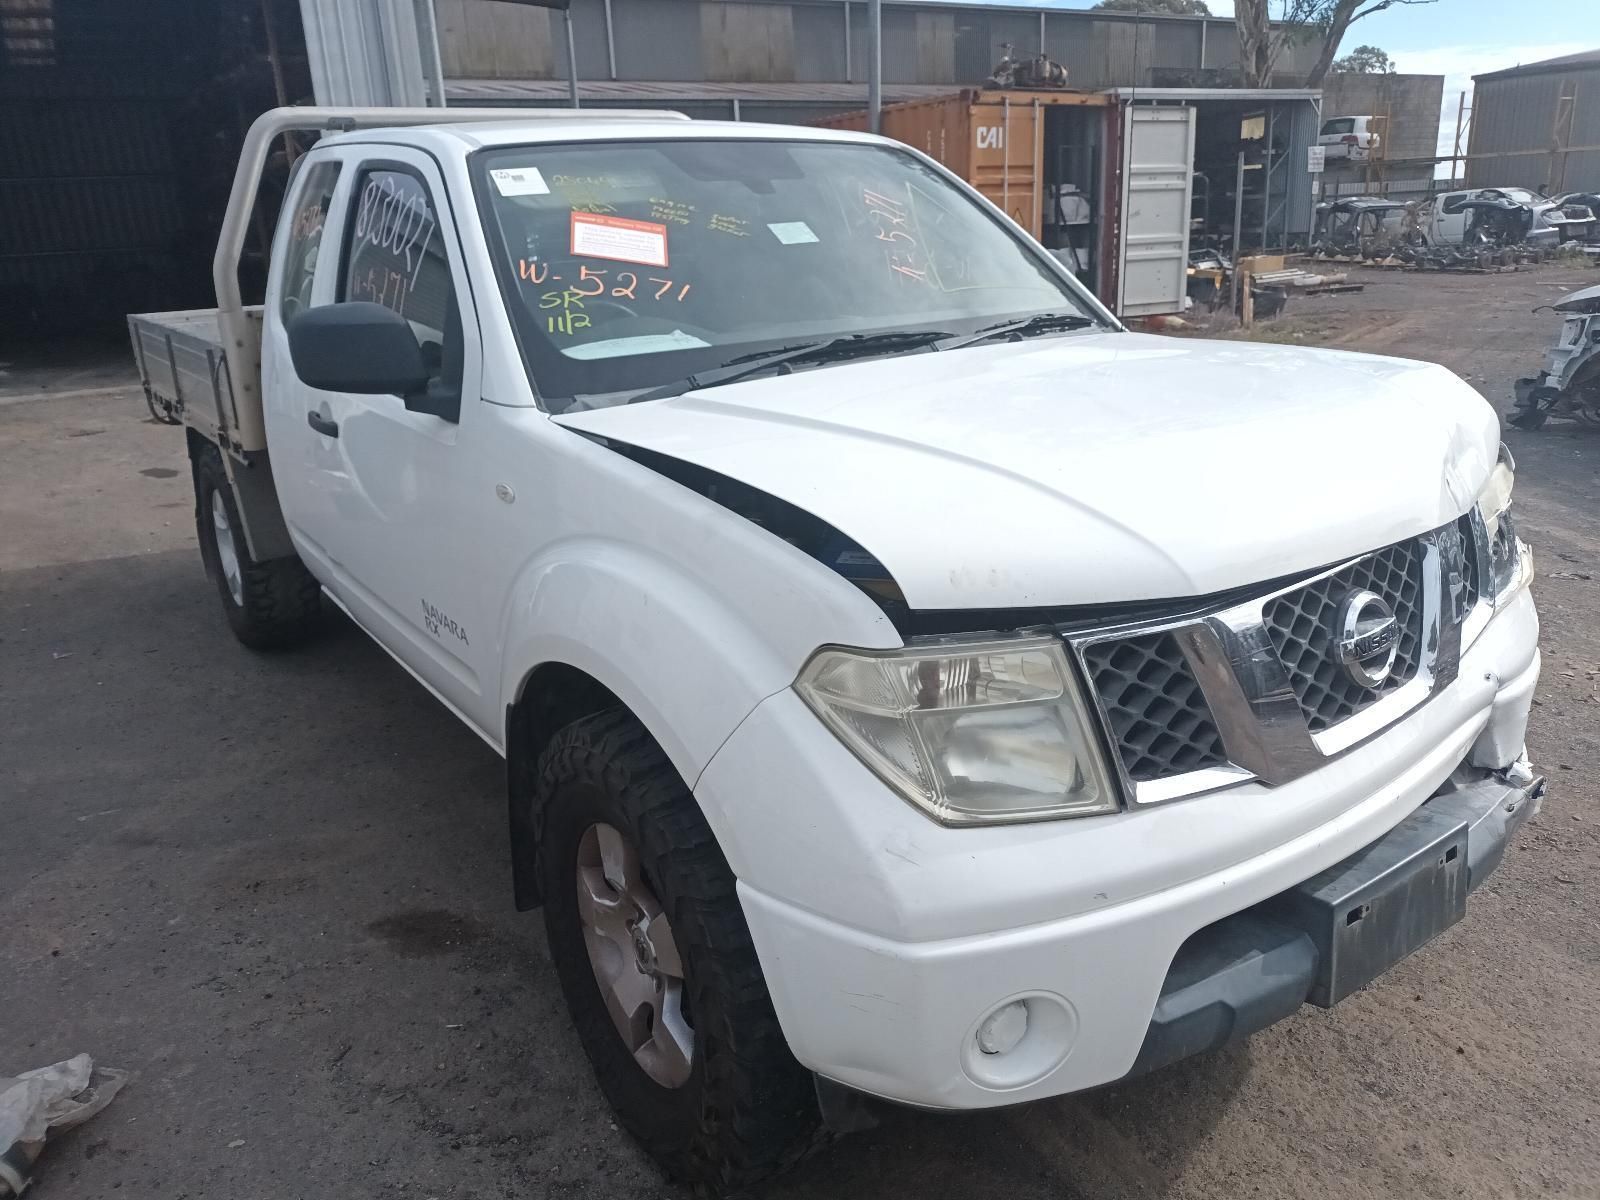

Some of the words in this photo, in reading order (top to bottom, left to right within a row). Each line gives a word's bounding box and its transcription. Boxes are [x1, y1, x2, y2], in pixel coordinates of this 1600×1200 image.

[976, 126, 1003, 149] CAI
[538, 290, 585, 309] SR
[421, 598, 469, 647] NAVARA
[424, 614, 441, 638] RX
